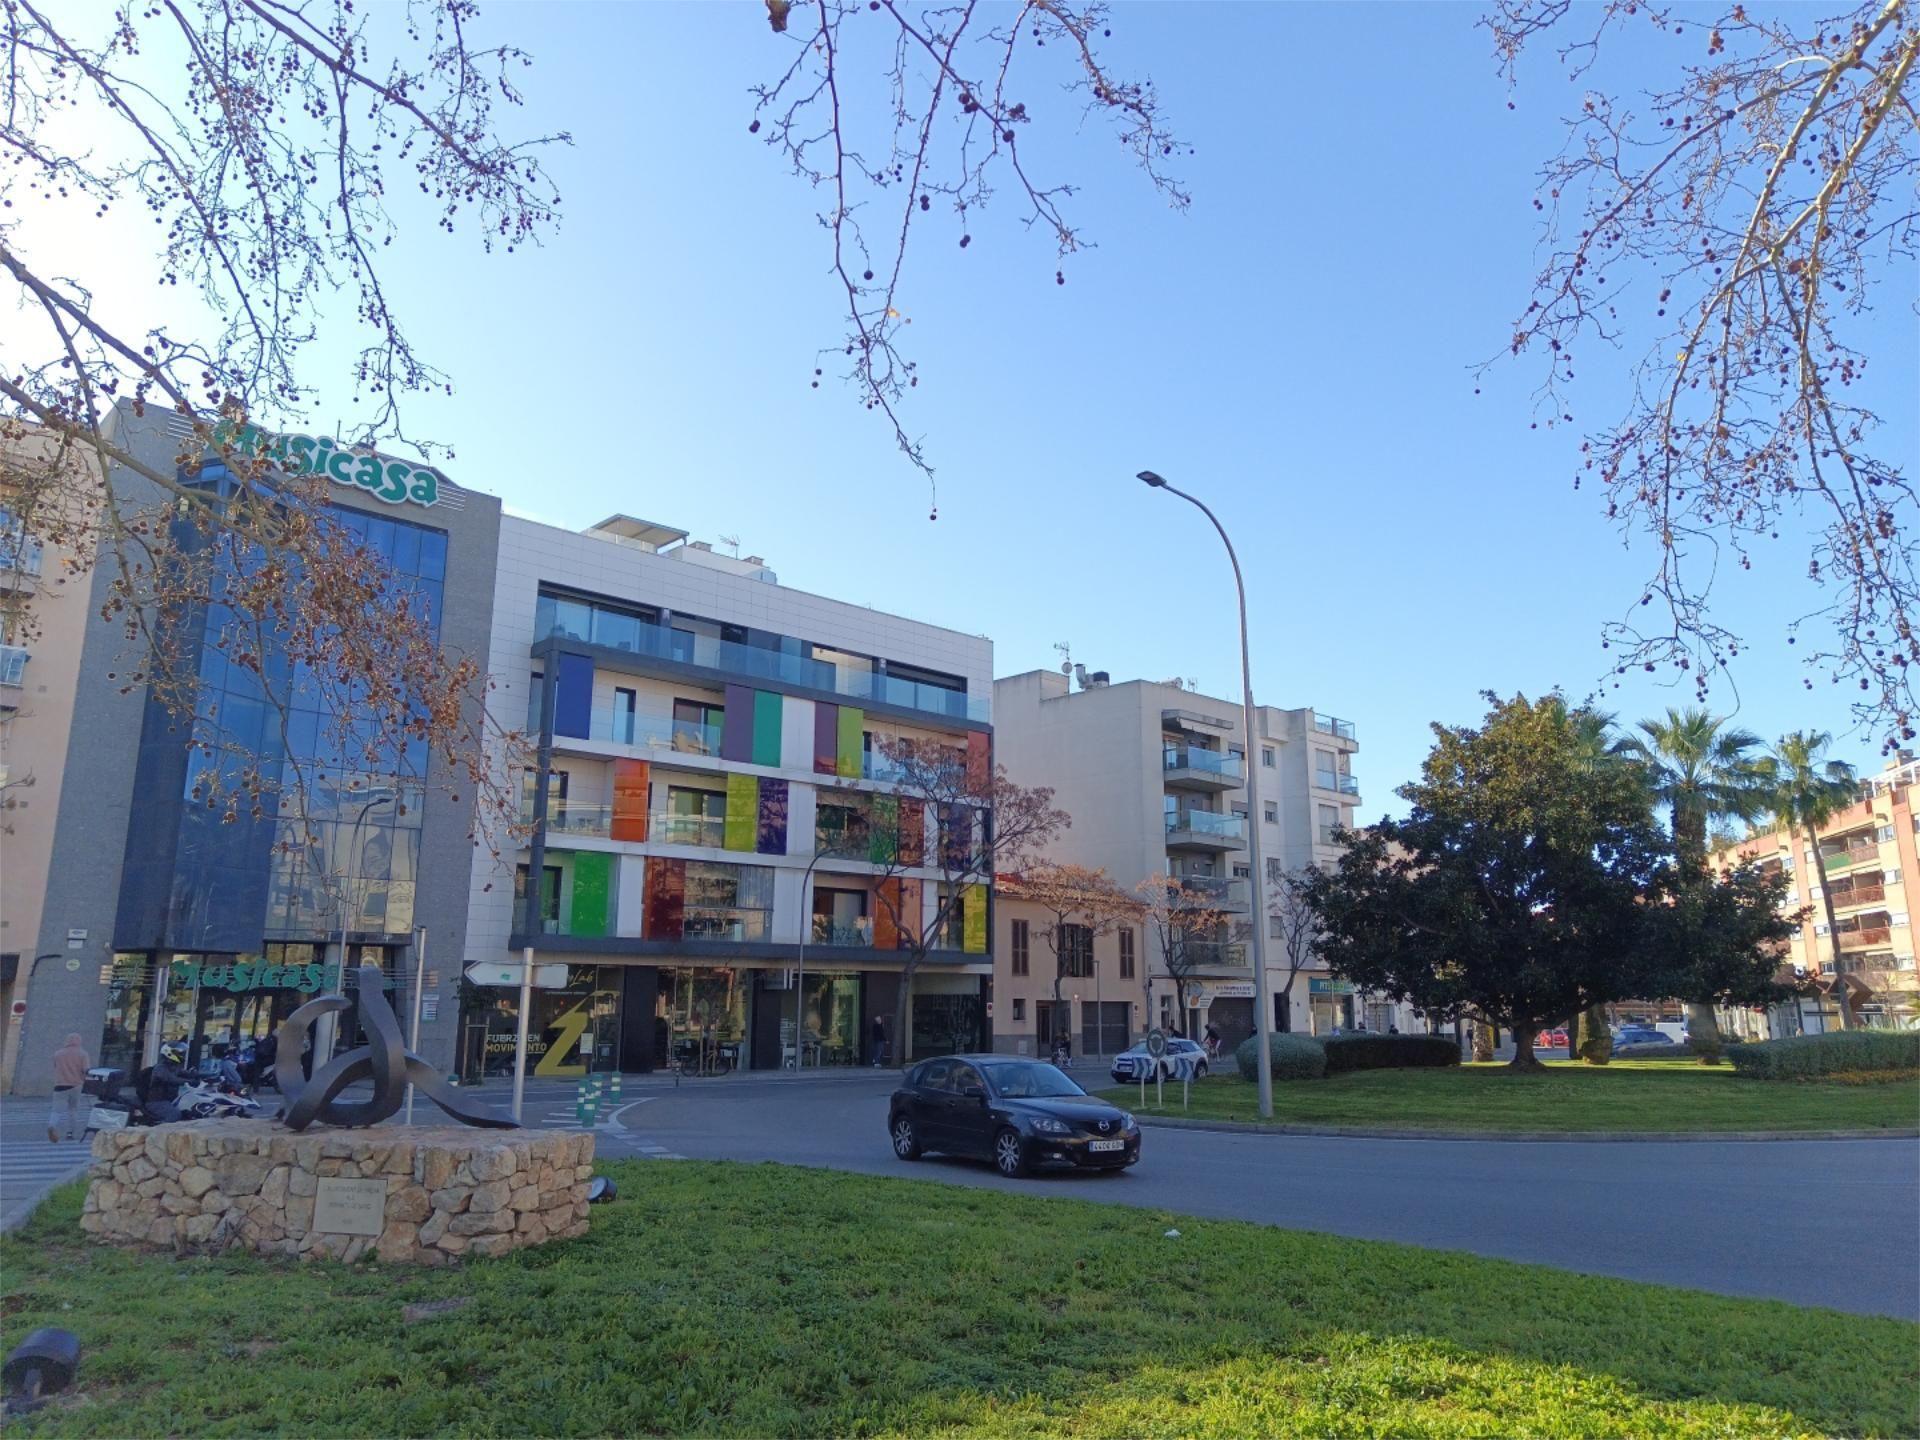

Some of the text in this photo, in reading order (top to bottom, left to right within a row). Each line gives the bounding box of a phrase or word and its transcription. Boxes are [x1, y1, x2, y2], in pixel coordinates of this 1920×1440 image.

[487, 1033, 541, 1043] FUERZ EN
[486, 1043, 547, 1053] MOVIMNTO
